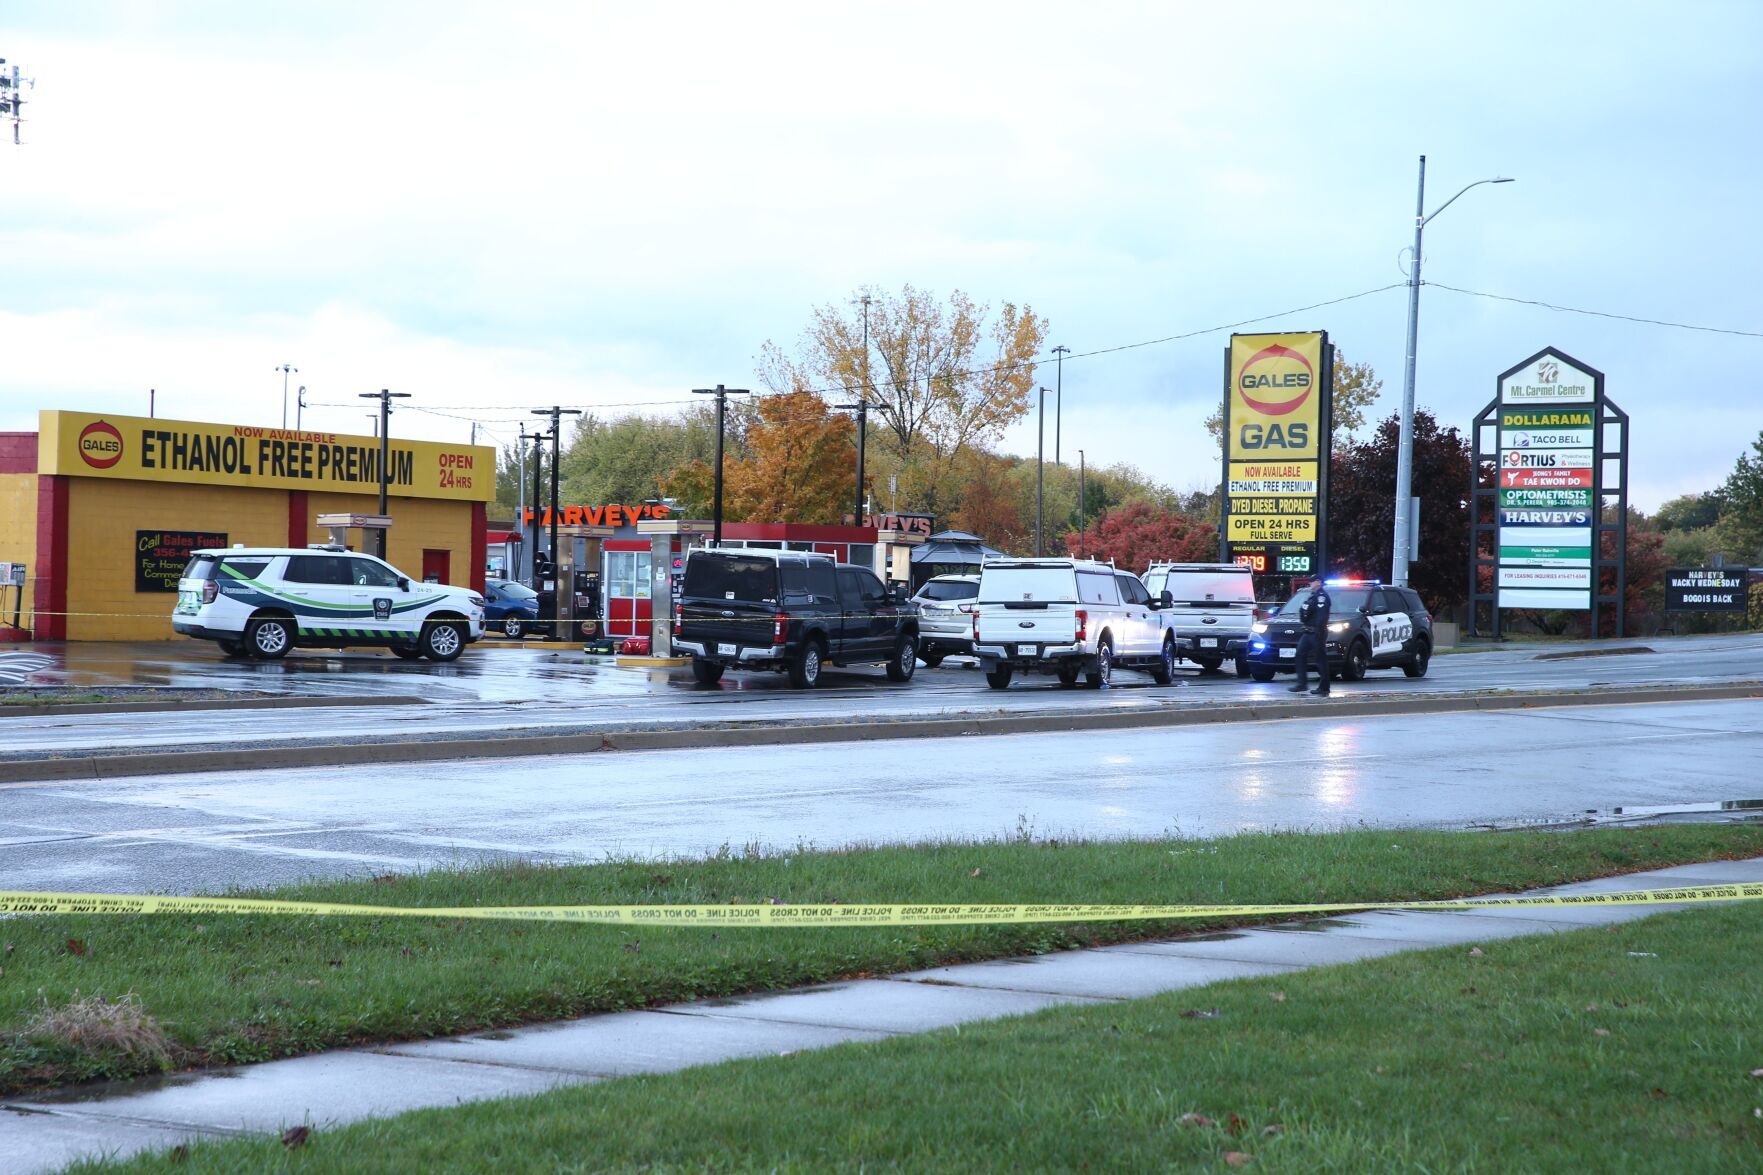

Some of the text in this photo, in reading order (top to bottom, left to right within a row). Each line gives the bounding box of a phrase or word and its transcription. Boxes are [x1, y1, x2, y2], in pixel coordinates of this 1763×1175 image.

[1242, 373, 1310, 388] GALES
[1511, 385, 1586, 396] Mt. Carmel Centre
[1504, 414, 1591, 426] DOLLARAMA
[234, 426, 336, 444] NOW AVAILABLE
[1240, 423, 1308, 449] GAS
[83, 439, 119, 452] GALES
[142, 430, 413, 485] ETHANOL FREE PREMIUM
[438, 454, 473, 469] OPEN
[1503, 451, 1556, 466] FORTIUS
[1245, 466, 1301, 477] NOW AVAILABLE
[439, 469, 472, 489] 24 HRS
[1231, 481, 1312, 492] ETHANOL FREE PREMIUM
[1507, 490, 1586, 499] OPTOMETRISTS
[1232, 499, 1312, 513] DYED DIESEL PROPANE
[523, 504, 670, 526] HARVEY'S
[1506, 512, 1586, 522] HARVEY'S
[1235, 520, 1310, 529] OPEN 24 HRS
[139, 533, 225, 551] Call Gales Fuels
[153, 548, 190, 557] 356-4
[142, 559, 184, 568] For Home
[1282, 556, 1310, 571] 1359
[145, 569, 182, 578] Commer
[1698, 579, 1740, 587] WEDNESDAY
[1381, 624, 1412, 643] POLICE
